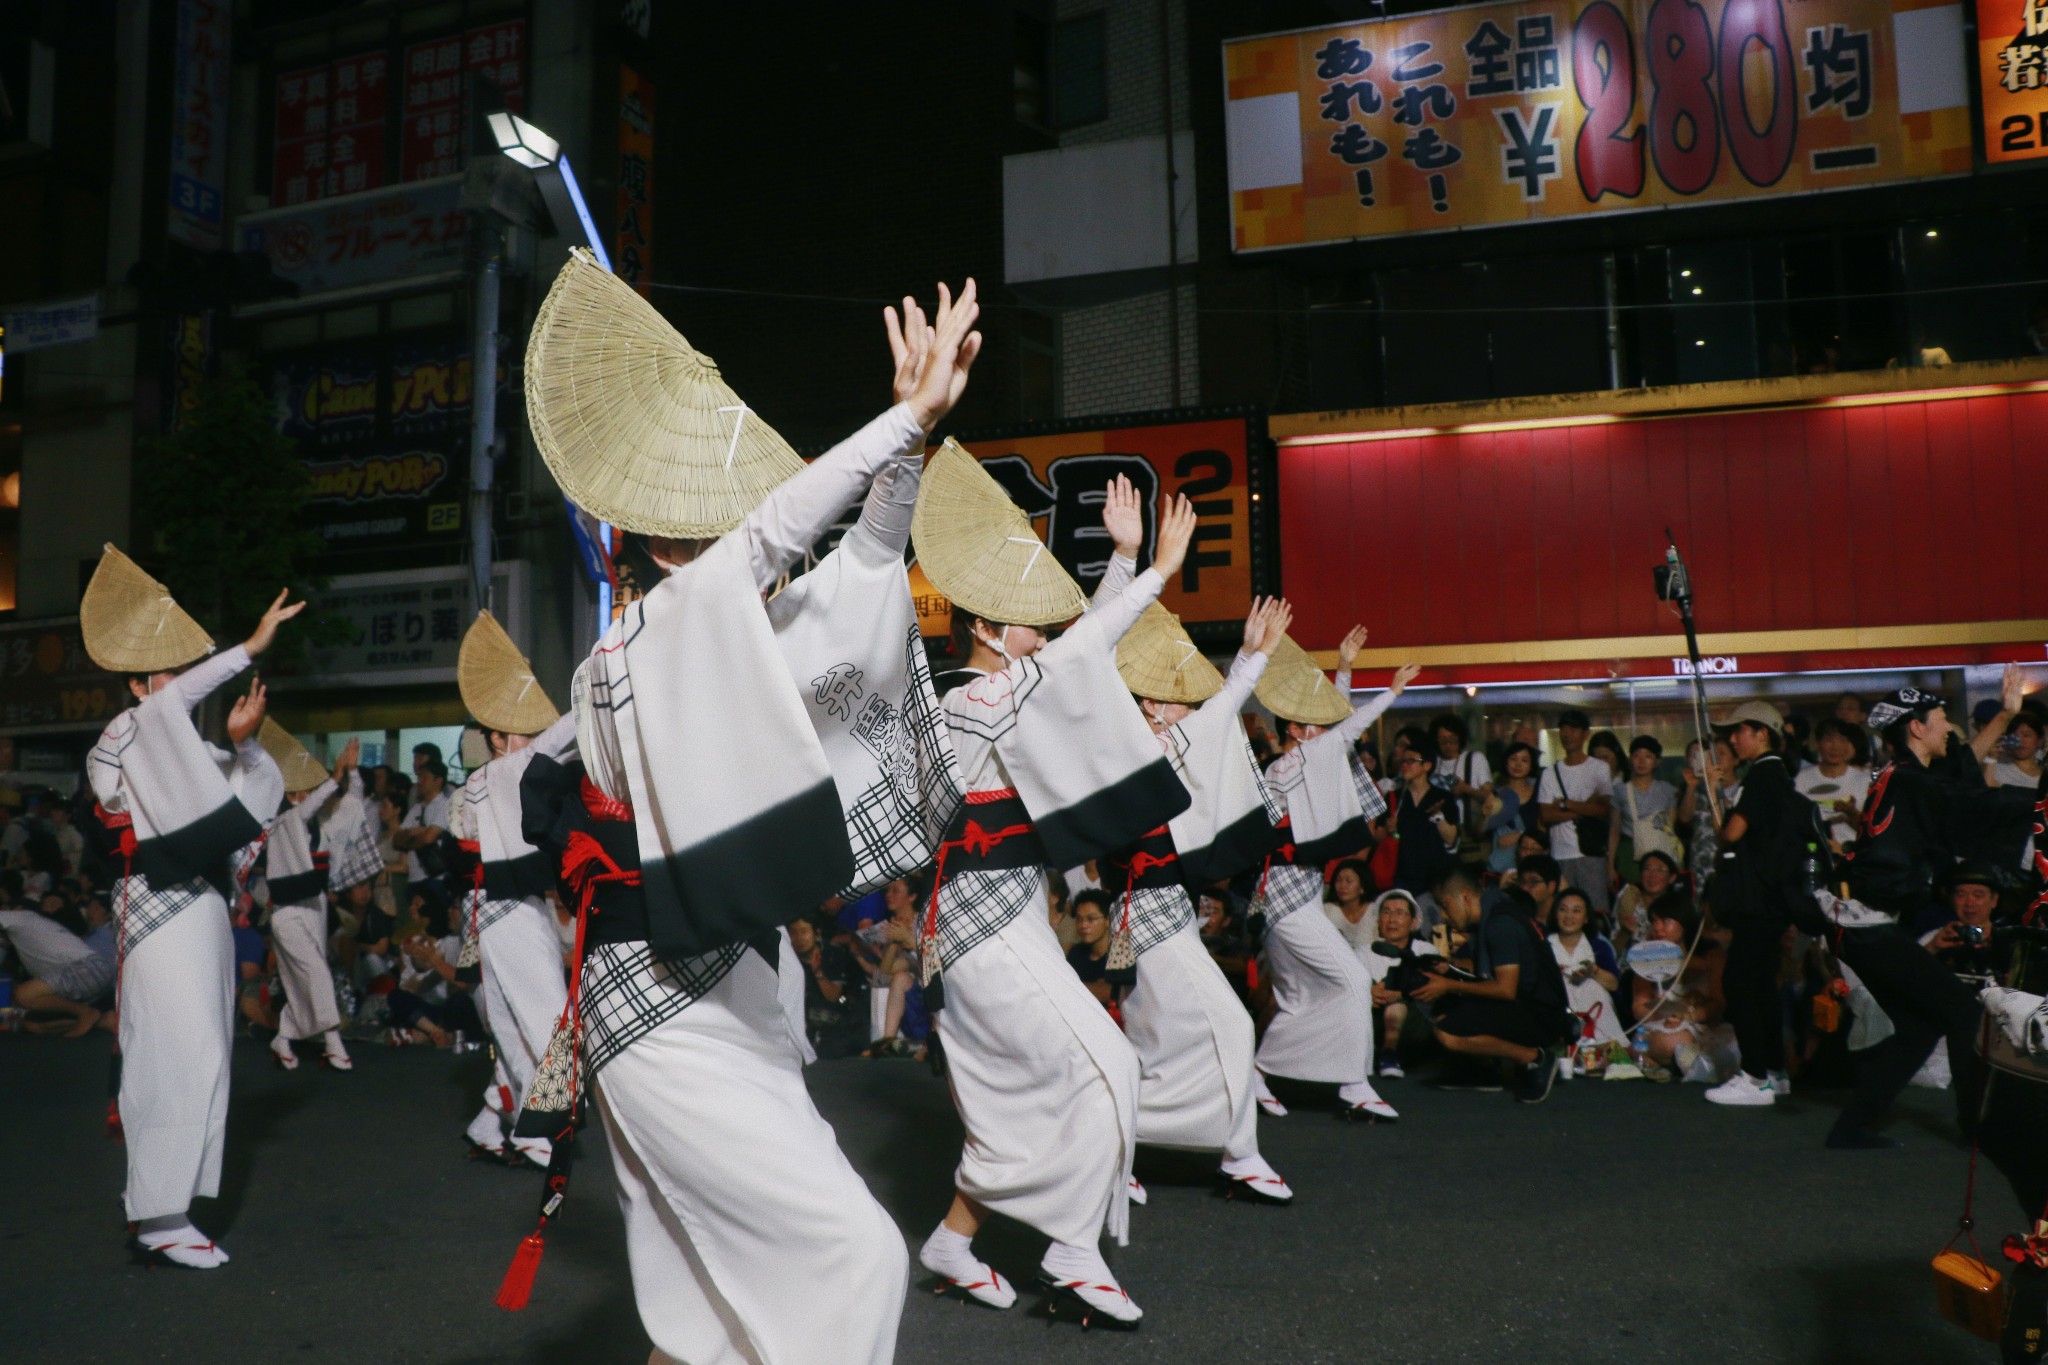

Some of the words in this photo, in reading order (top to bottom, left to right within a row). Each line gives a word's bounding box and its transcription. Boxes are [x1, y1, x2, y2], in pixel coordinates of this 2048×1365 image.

[1465, 16, 1560, 96] 全品
[1807, 27, 1877, 170] 均一
[2000, 45, 2048, 92] 若
[1315, 38, 1389, 207] あれも！
[1393, 43, 1462, 213] これも！
[431, 507, 460, 527] 2F
